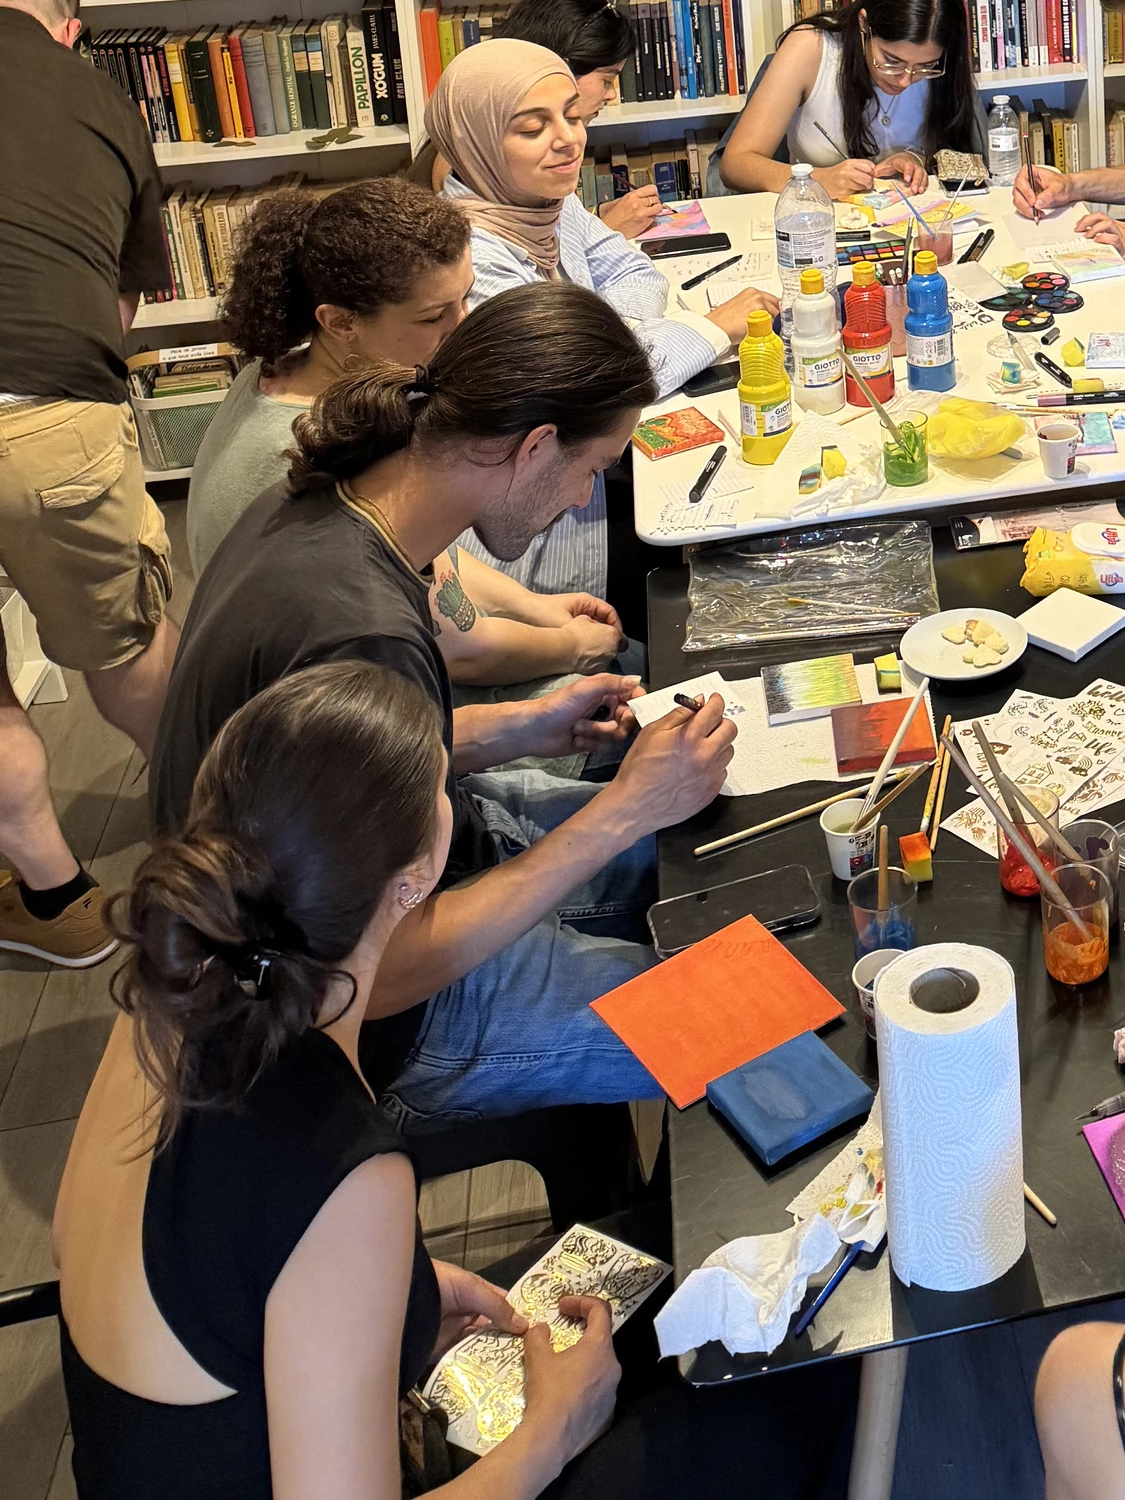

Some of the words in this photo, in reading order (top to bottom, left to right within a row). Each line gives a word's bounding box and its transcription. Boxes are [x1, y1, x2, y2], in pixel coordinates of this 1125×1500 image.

[351, 46, 370, 110] PAPILLON
[814, 357, 840, 372] GIOTTO
[852, 354, 882, 363] GIOTTO
[1105, 527, 1117, 545] Ultra
[1100, 573, 1124, 584] Ultra
